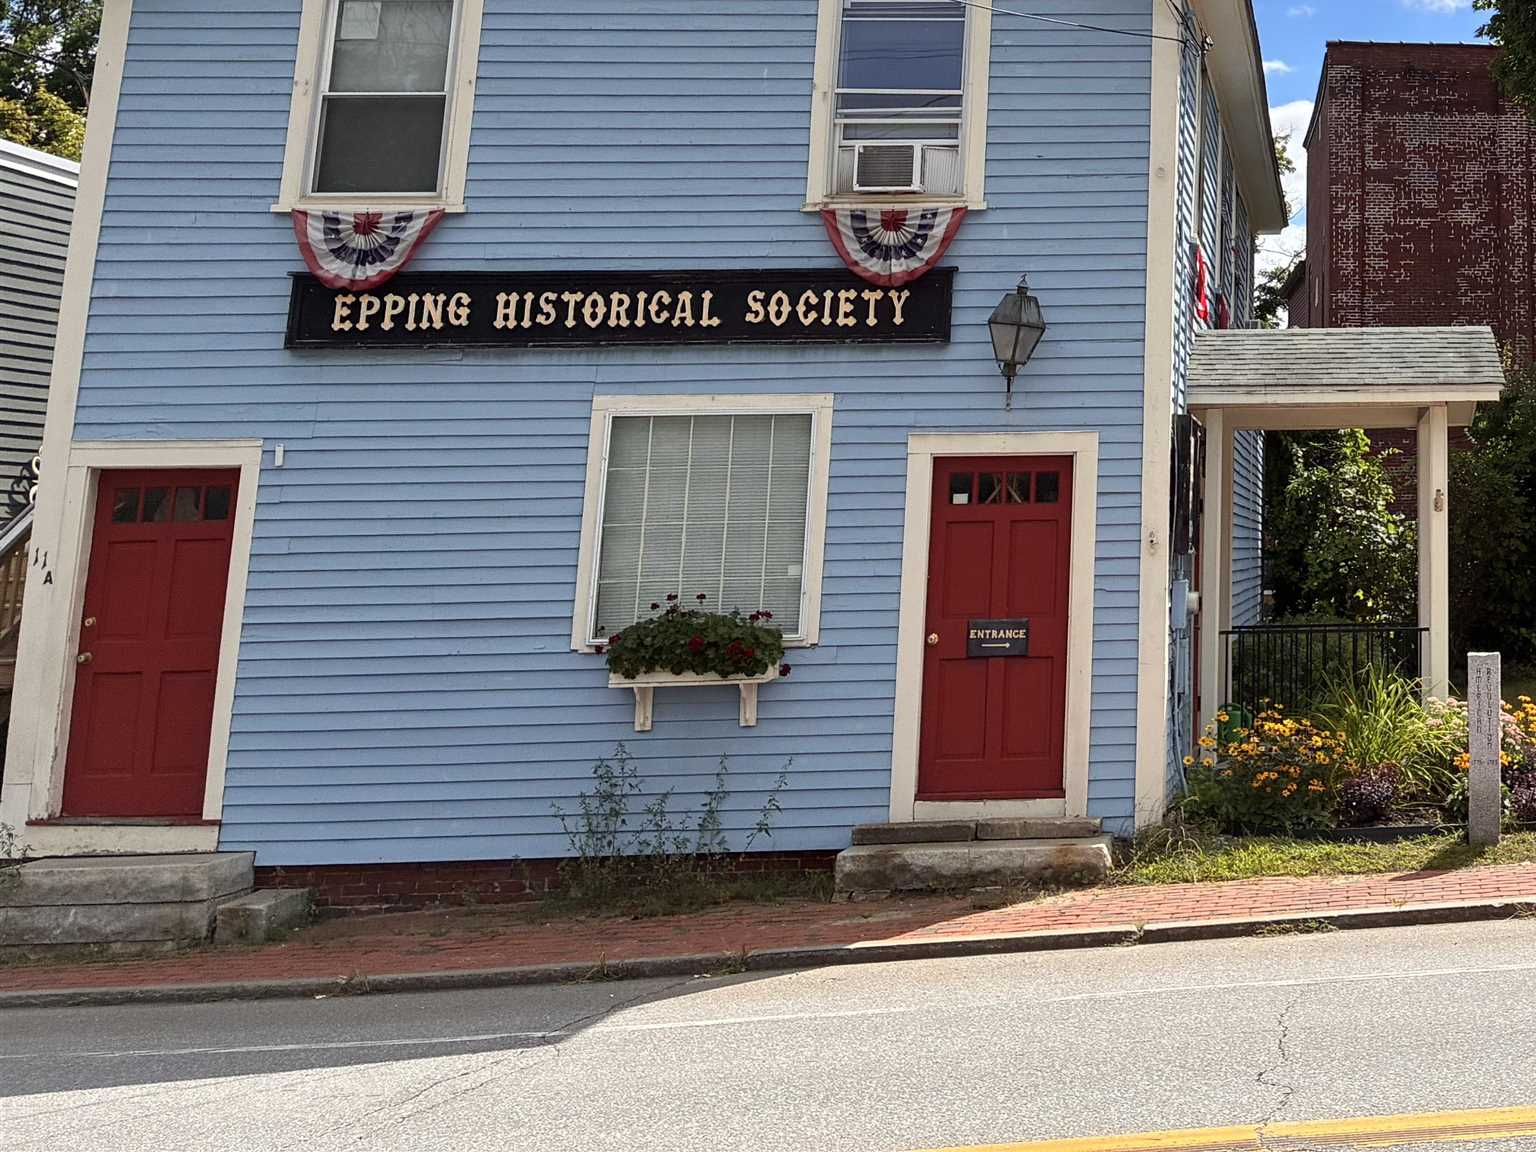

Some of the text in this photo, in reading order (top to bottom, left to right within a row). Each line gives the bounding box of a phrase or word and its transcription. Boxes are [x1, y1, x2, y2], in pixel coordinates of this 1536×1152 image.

[331, 289, 910, 331] EPPING HISTORICAL SOCIETY
[33, 547, 48, 570] 11
[43, 570, 53, 585] A
[969, 629, 1026, 639] ENTRANCE
